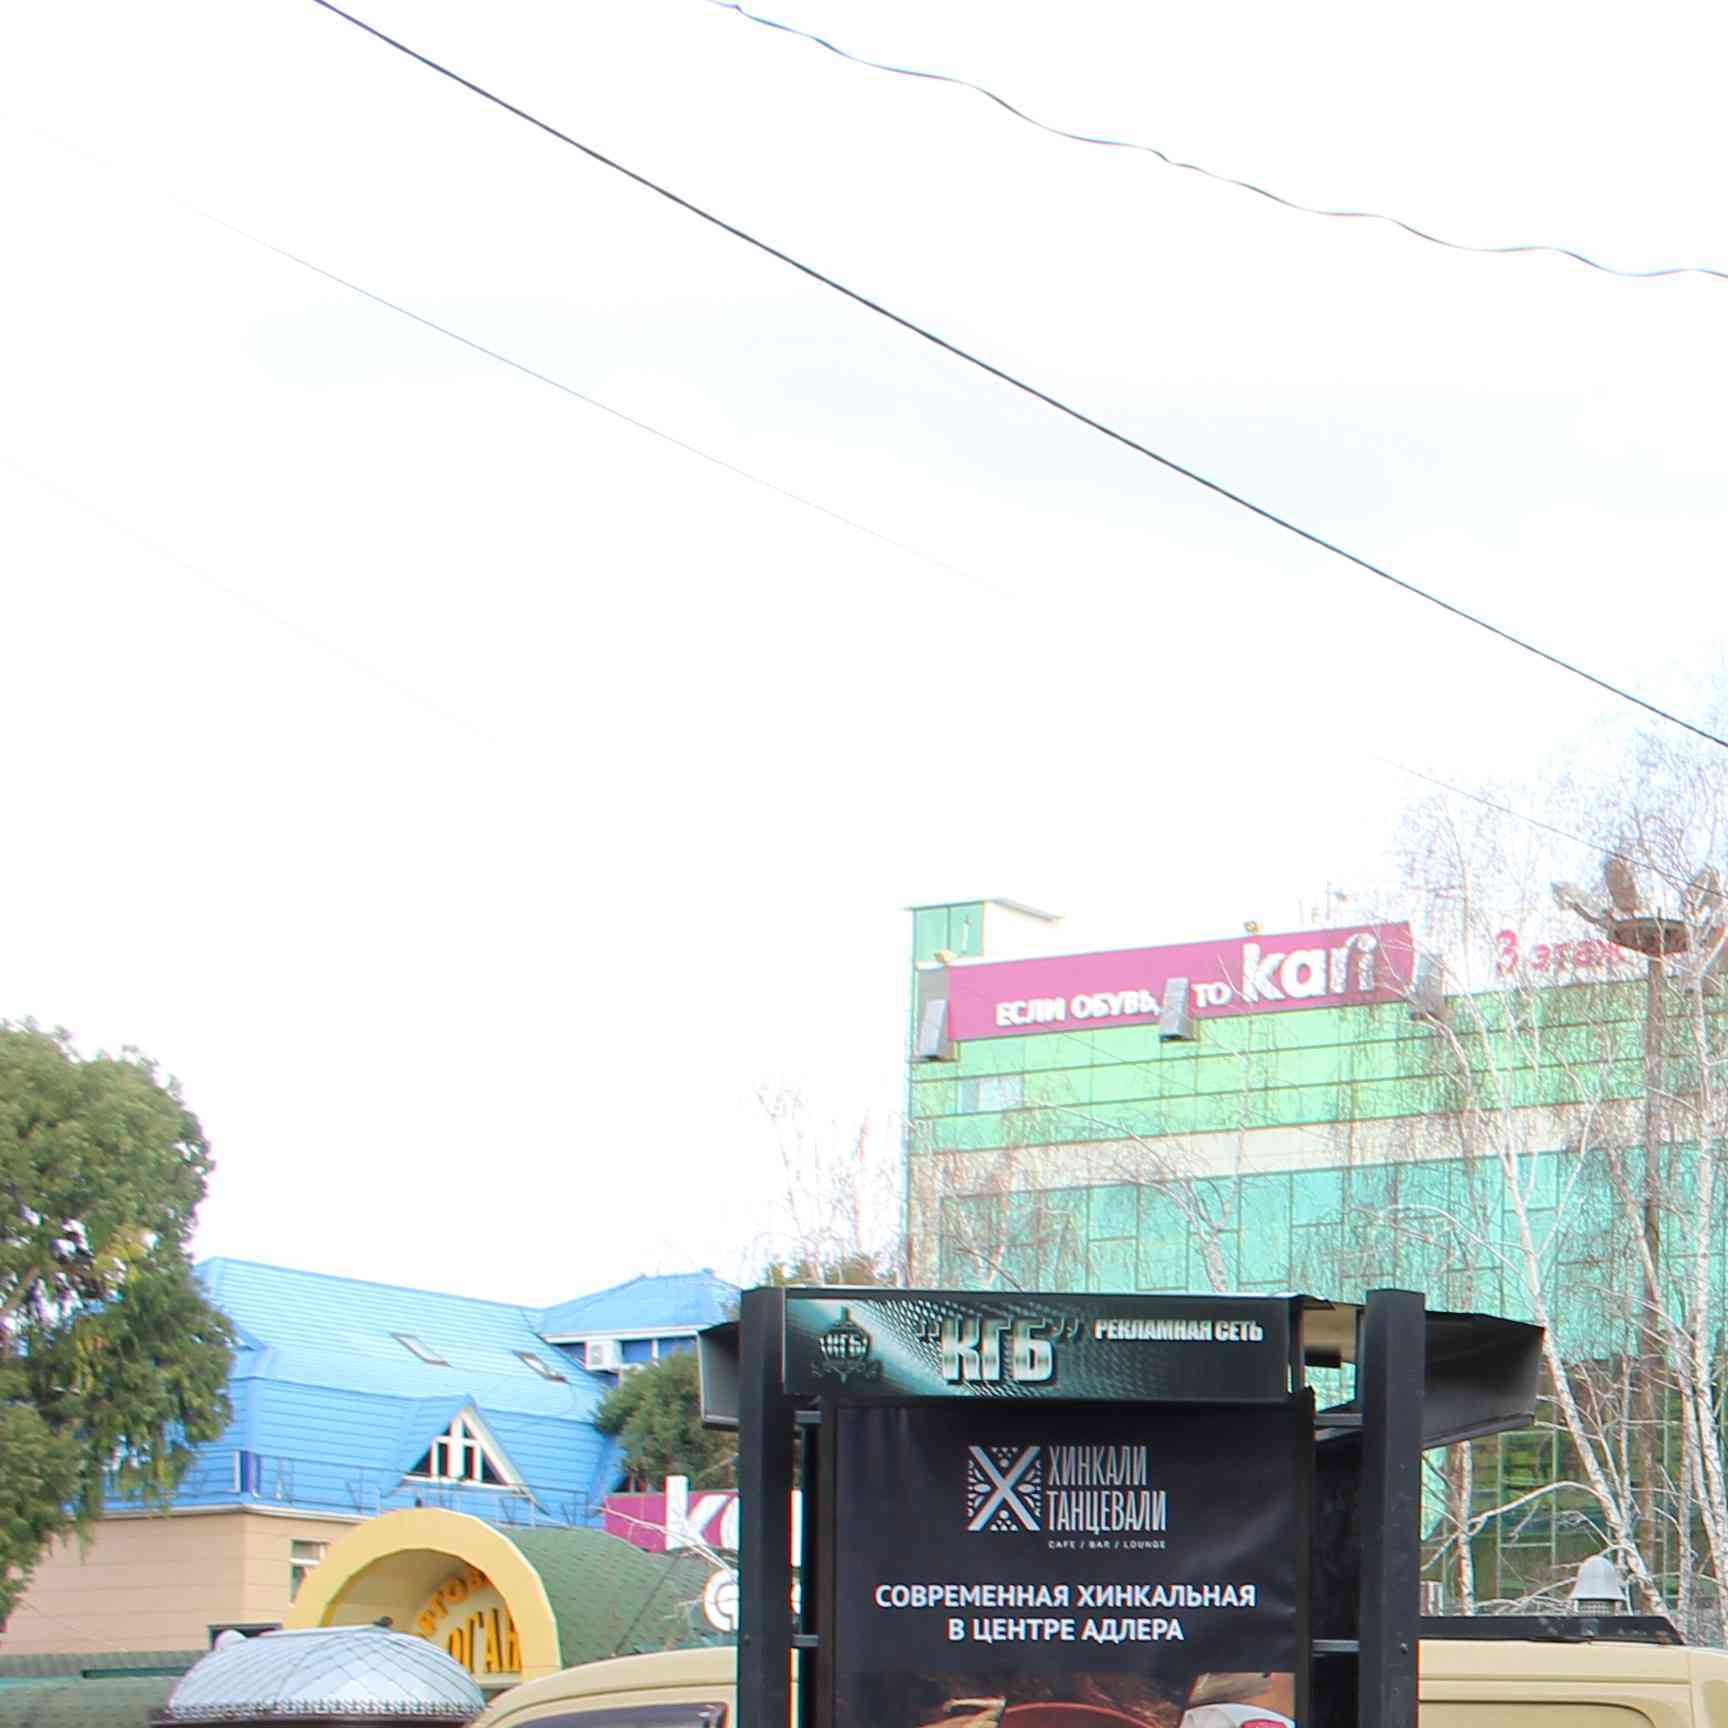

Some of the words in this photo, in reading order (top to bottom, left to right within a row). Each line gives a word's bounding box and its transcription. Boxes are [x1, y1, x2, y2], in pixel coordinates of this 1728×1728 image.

[1495, 928, 1520, 977] 3
[996, 996, 1066, 1028] ЕСЛИ
[1192, 981, 1234, 1010] ТО
[1241, 931, 1378, 1003] kari
[1094, 1318, 1213, 1342] РЕКЛАМНАЯ
[1214, 1319, 1265, 1343] СЕТЬ
[1047, 1445, 1148, 1487] ХИНКАЛИ
[1045, 1490, 1168, 1535] ТАНЦЕВАЛИ
[1047, 1540, 1076, 1550] CAFE
[1088, 1540, 1111, 1550] BAR
[1122, 1540, 1167, 1550] LOUNGE
[875, 1584, 1071, 1608] СОВРЕМЕННАЯ
[1076, 1584, 1257, 1608] ХИНКАЛЬНАЯ
[948, 1618, 966, 1641] В
[973, 1618, 1076, 1644] ЦЕНТРЕ
[1081, 1618, 1185, 1644] АДЛЕРА
